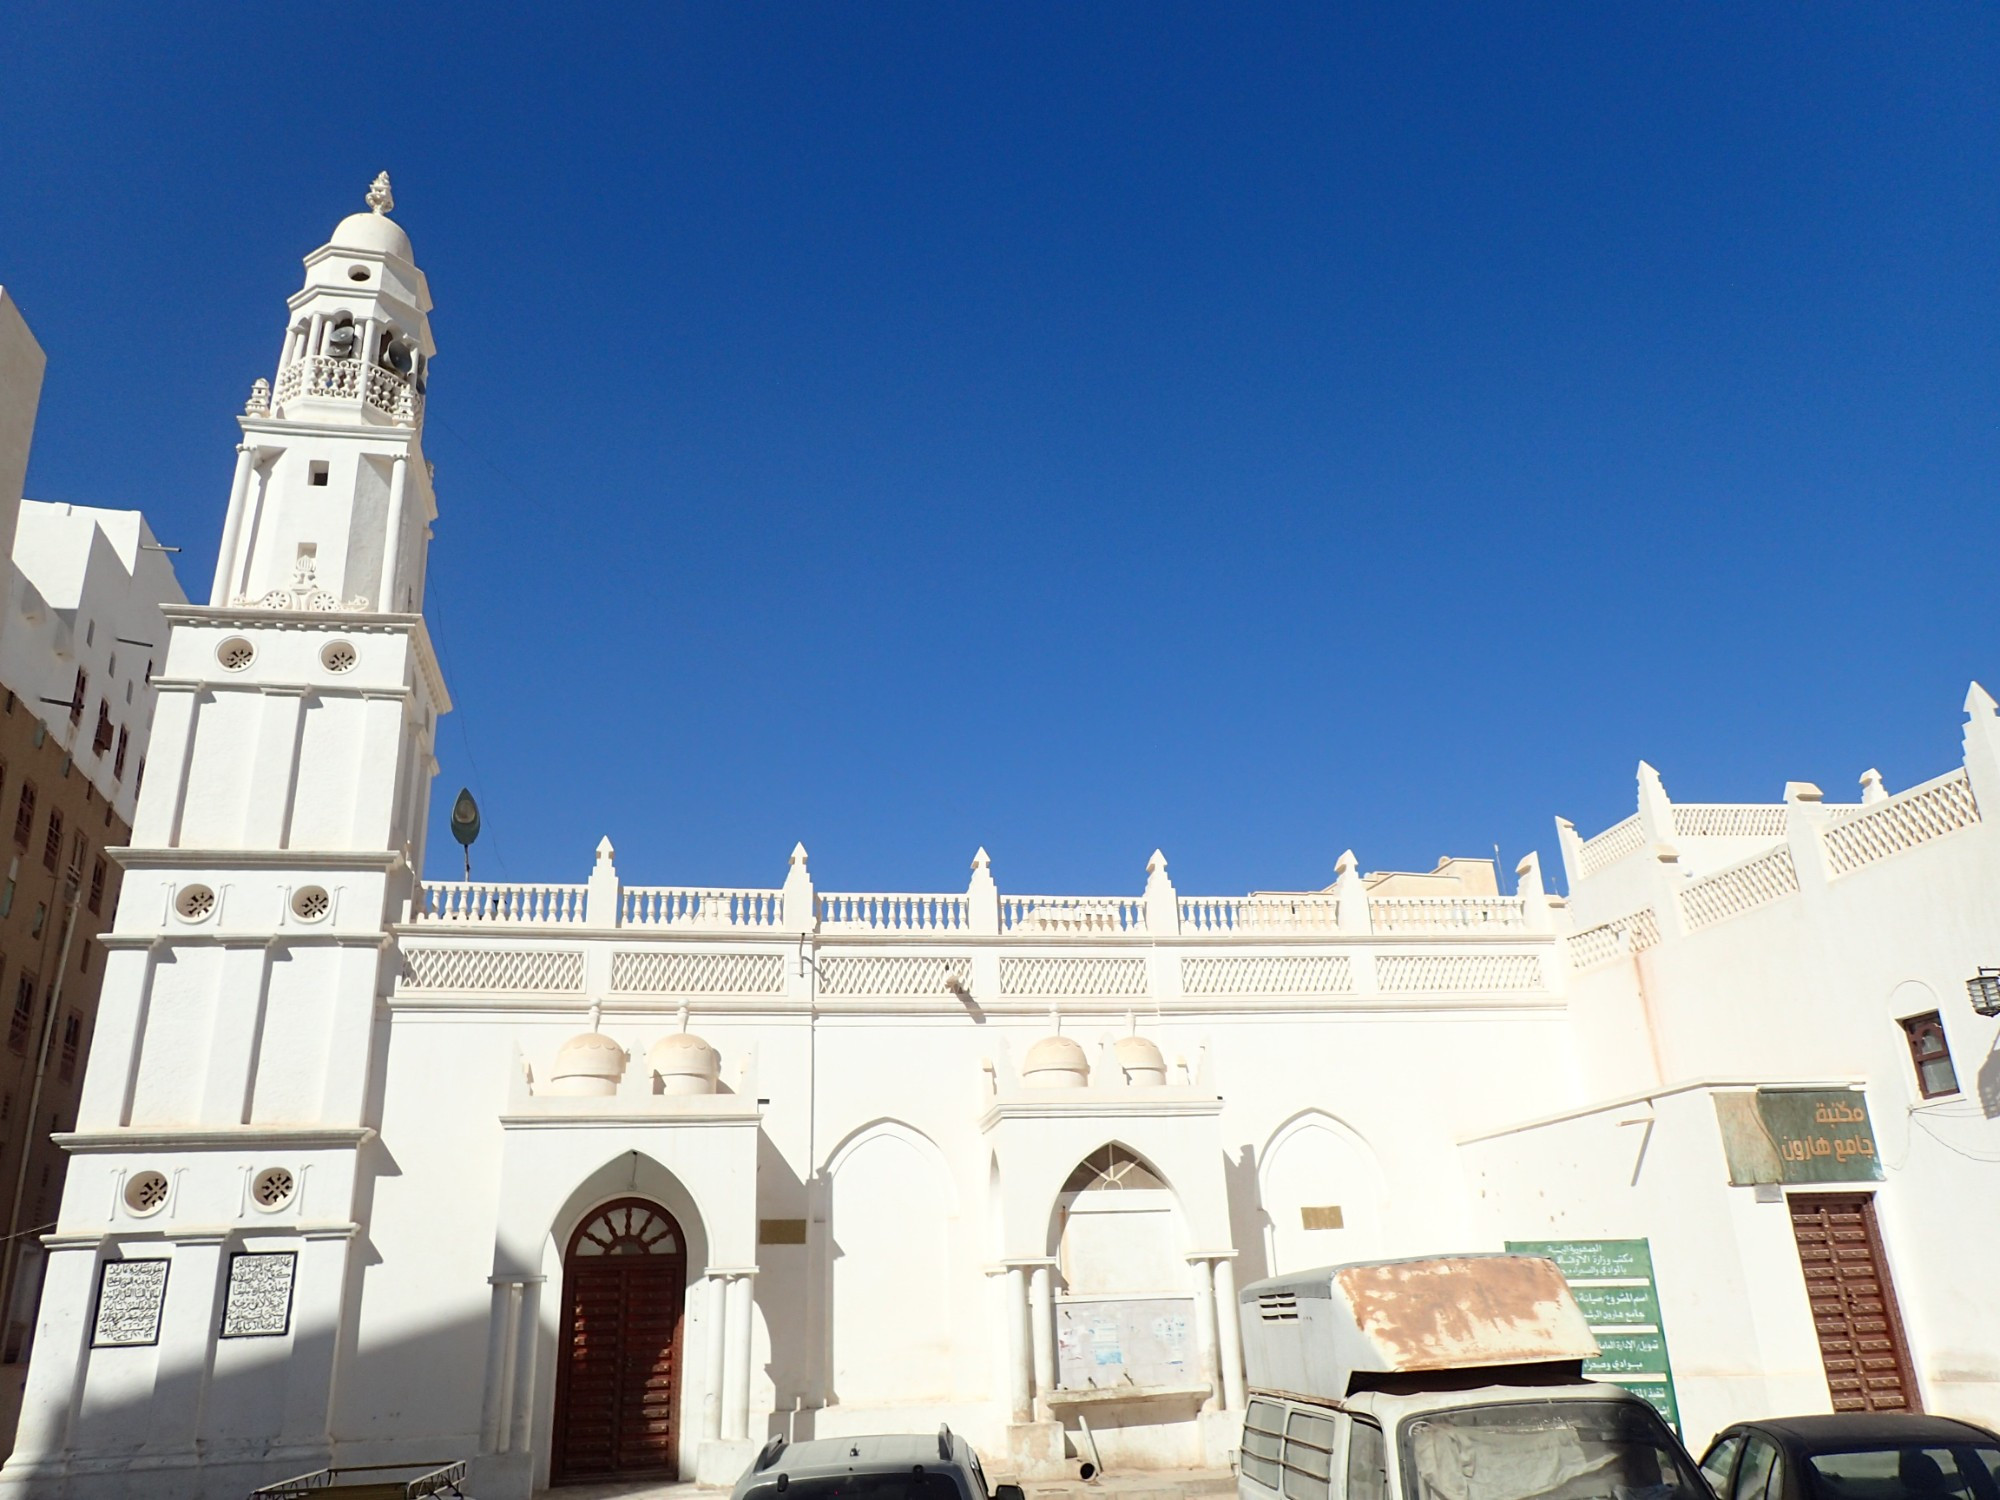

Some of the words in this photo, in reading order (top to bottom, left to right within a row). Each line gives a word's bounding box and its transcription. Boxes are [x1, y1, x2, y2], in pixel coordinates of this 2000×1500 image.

[1815, 1101, 1865, 1129] مكتبة
[1781, 1135, 1831, 1162] هارون
[1833, 1134, 1875, 1163] جامع
[1592, 1254, 1611, 1265] وزارة
[1612, 1253, 1634, 1264] مكتب
[1633, 1292, 1649, 1307] اسم
[1603, 1310, 1623, 1320] هارون
[1626, 1309, 1645, 1322] جامع
